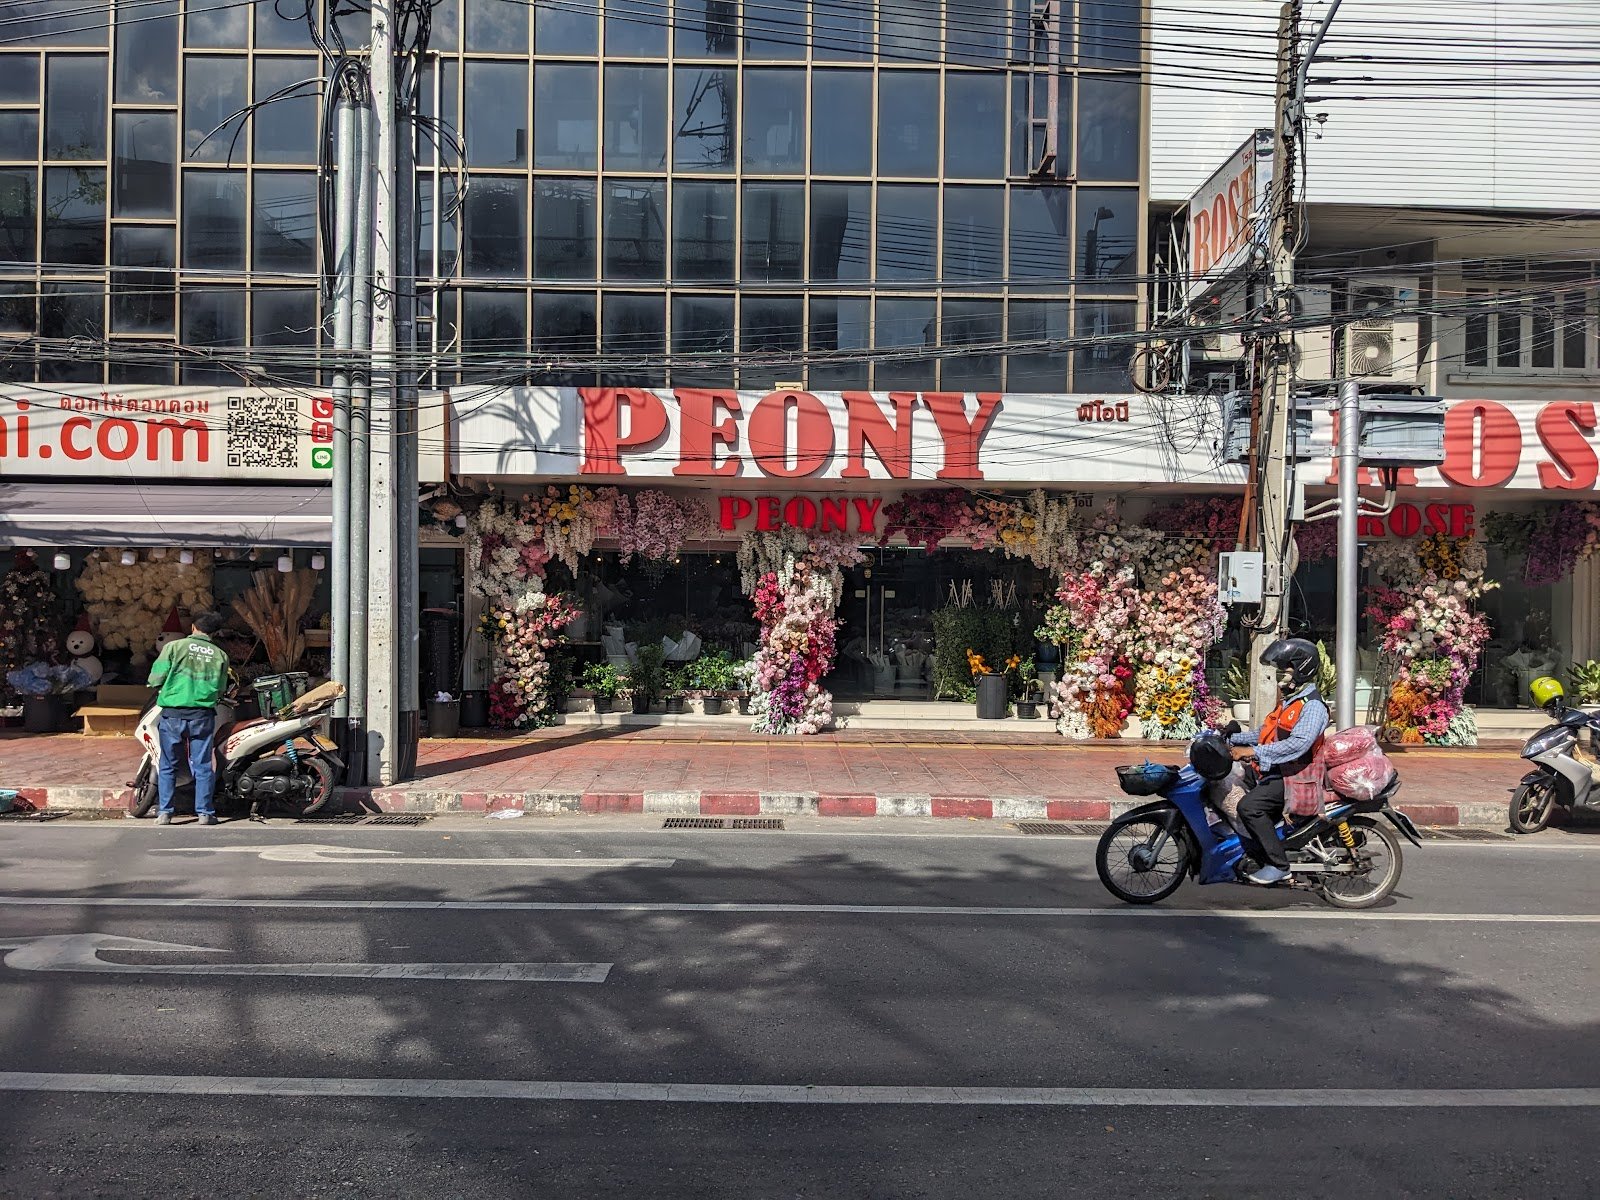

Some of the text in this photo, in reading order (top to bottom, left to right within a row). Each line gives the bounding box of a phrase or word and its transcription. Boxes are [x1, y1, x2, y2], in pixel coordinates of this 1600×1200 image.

[1193, 165, 1254, 277] ROSE
[578, 388, 1003, 479] PEONY
[720, 495, 884, 534] PEONY
[189, 643, 214, 655] Grab
